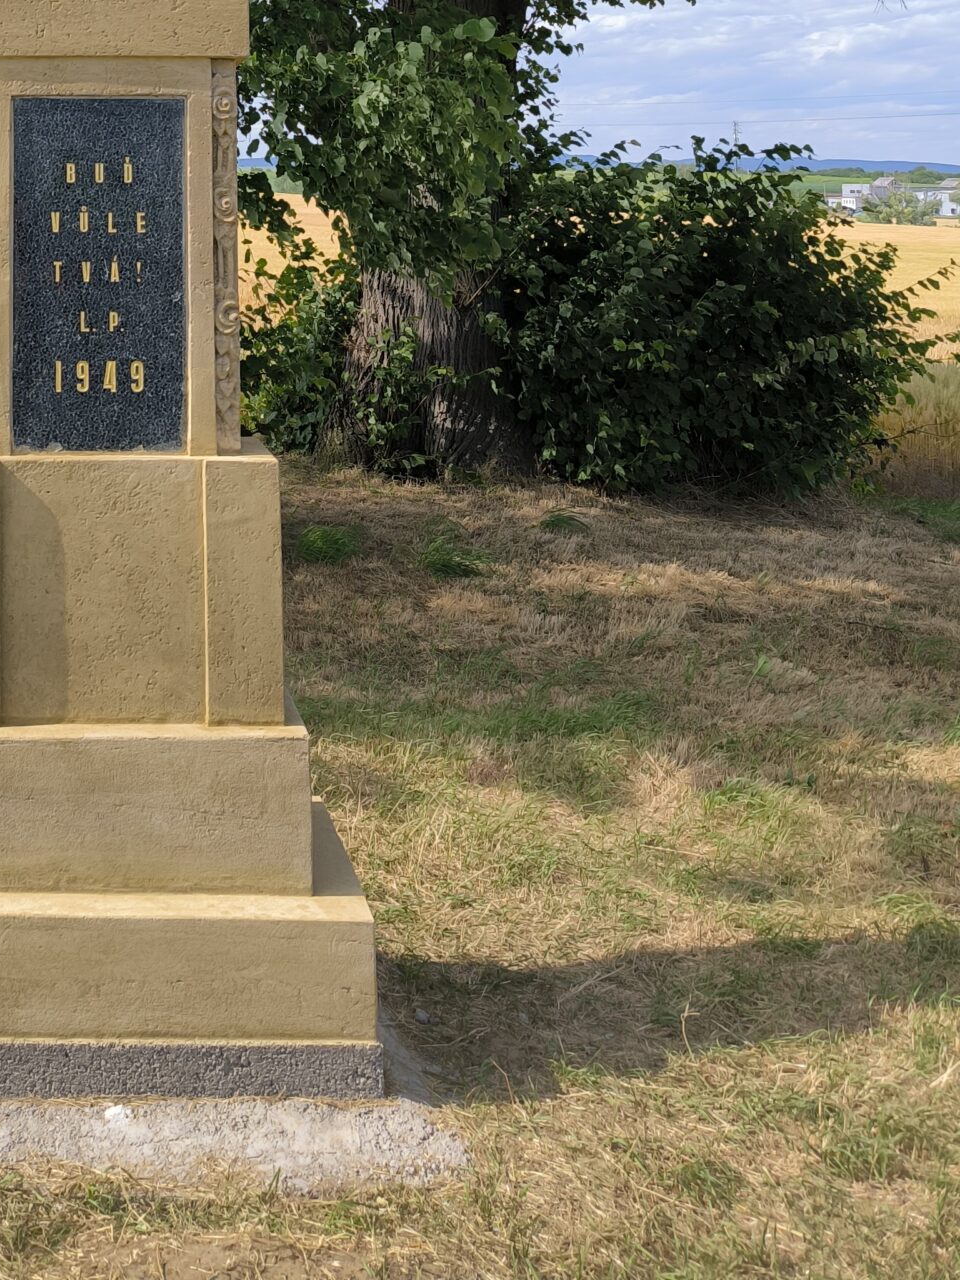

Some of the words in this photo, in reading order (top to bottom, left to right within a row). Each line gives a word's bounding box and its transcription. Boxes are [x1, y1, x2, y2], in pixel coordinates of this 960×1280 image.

[65, 157, 133, 184] BUĎ
[50, 206, 147, 234] VŮLE
[53, 255, 143, 284] TVÁ!
[53, 360, 145, 393] 1949
